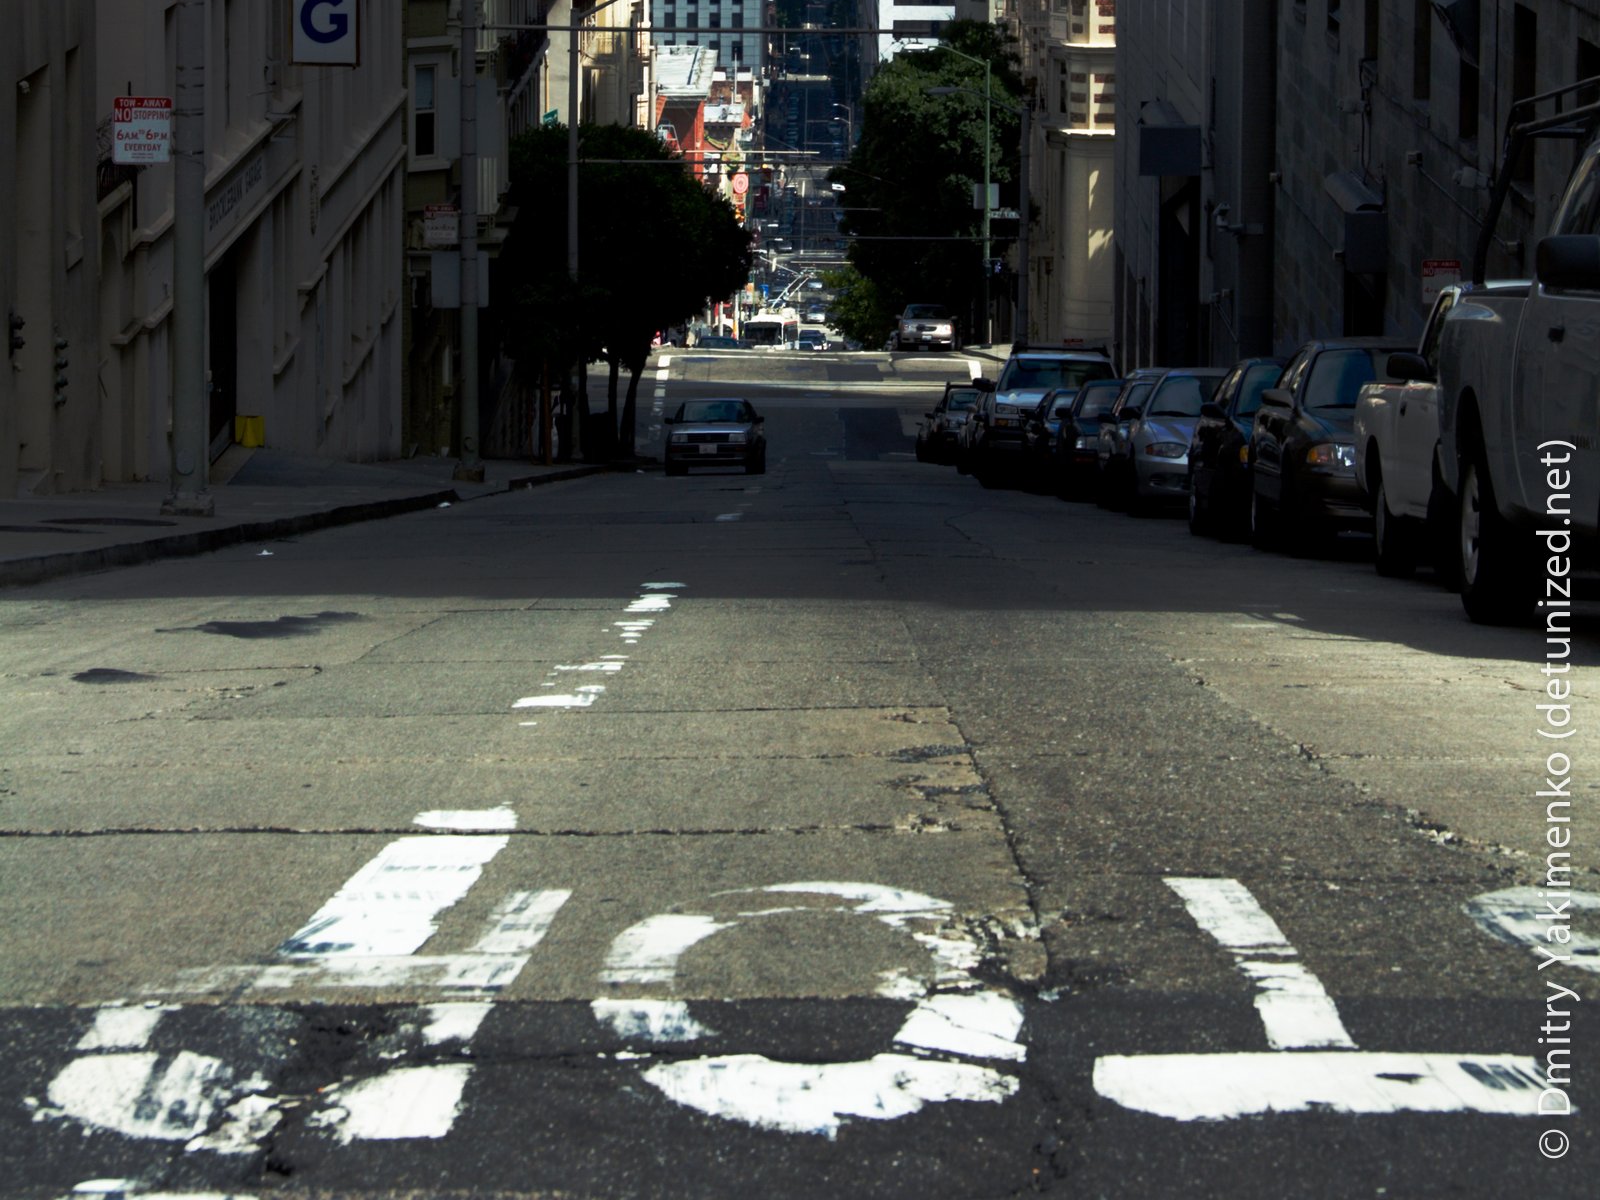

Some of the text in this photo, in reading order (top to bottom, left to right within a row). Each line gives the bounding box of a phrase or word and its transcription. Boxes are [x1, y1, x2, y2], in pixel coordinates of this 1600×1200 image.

[114, 108, 170, 121] NO STOPPING
[124, 143, 162, 152] EVERYDAY
